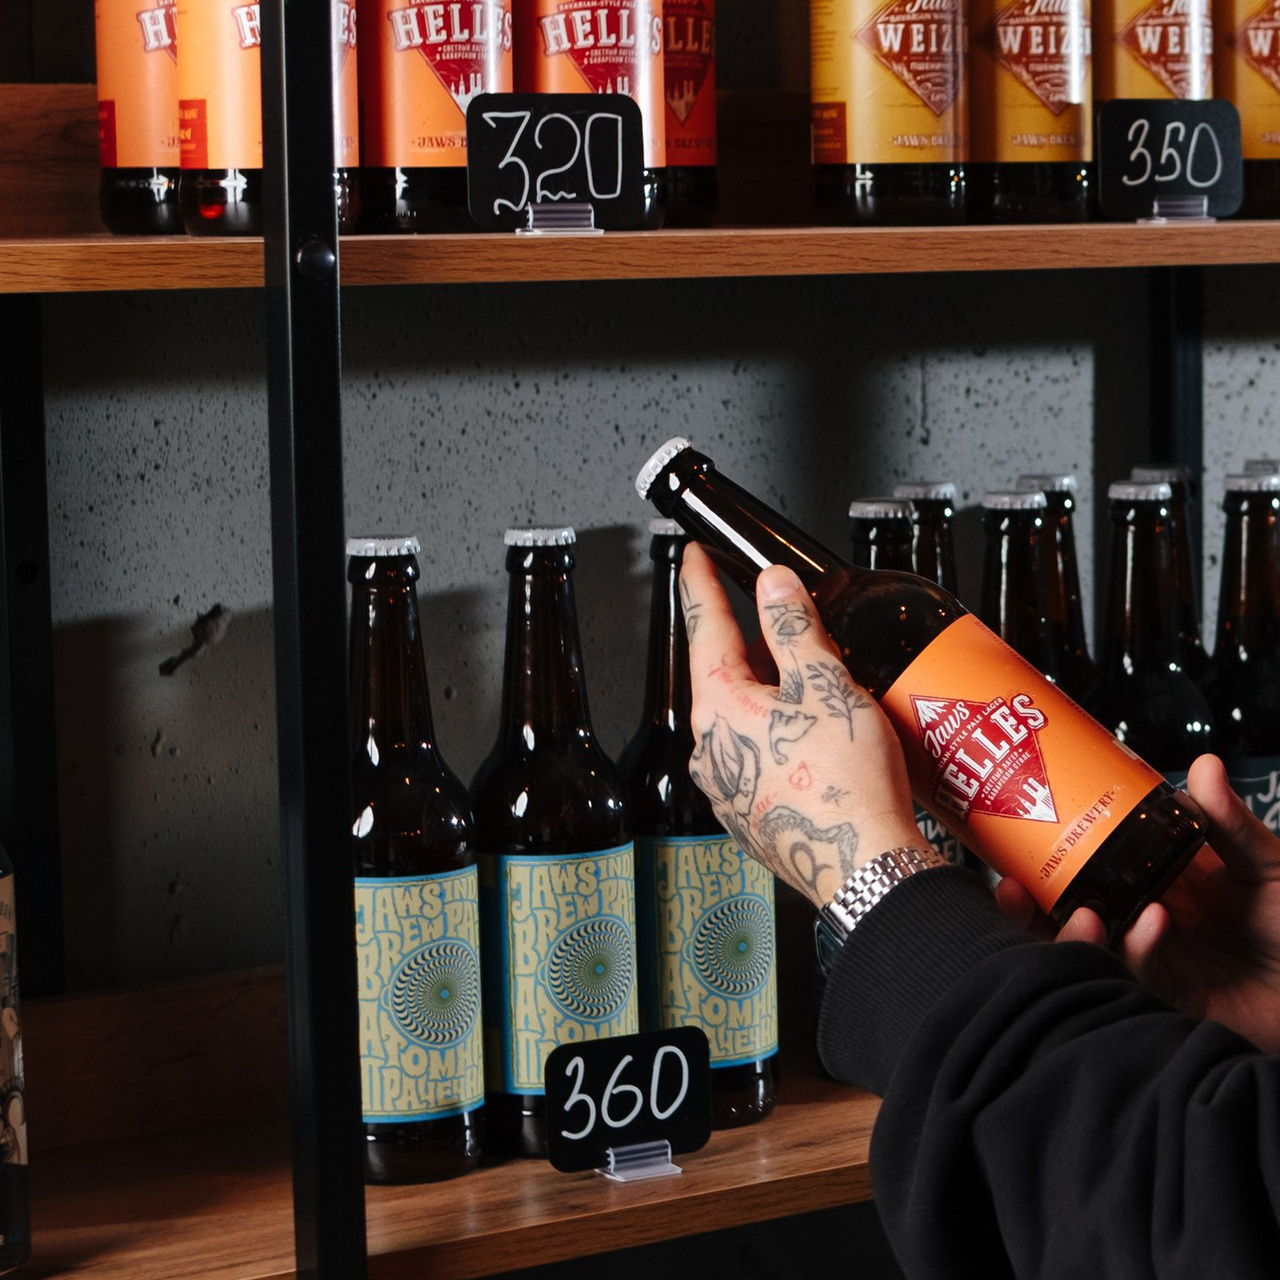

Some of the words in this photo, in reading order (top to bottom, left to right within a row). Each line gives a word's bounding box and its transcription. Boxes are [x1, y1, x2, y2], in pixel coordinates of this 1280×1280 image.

[389, 3, 512, 52] HELLES
[541, 9, 662, 56] HELLS
[482, 111, 622, 215] 320
[1121, 118, 1222, 188] 350
[924, 701, 970, 759] Jaws
[966, 714, 983, 732] PALE
[982, 697, 1005, 716] LAGER
[936, 693, 1046, 814] HELLES
[1040, 845, 1068, 878] JAWS
[1065, 790, 1115, 847] BREWERY
[511, 862, 598, 919] JAWS
[657, 844, 741, 901] JAWS
[355, 882, 442, 945] JAWS
[513, 894, 600, 976] BREW
[659, 873, 742, 954] BREW
[357, 915, 444, 1002] BREW
[561, 1045, 689, 1140] 360
